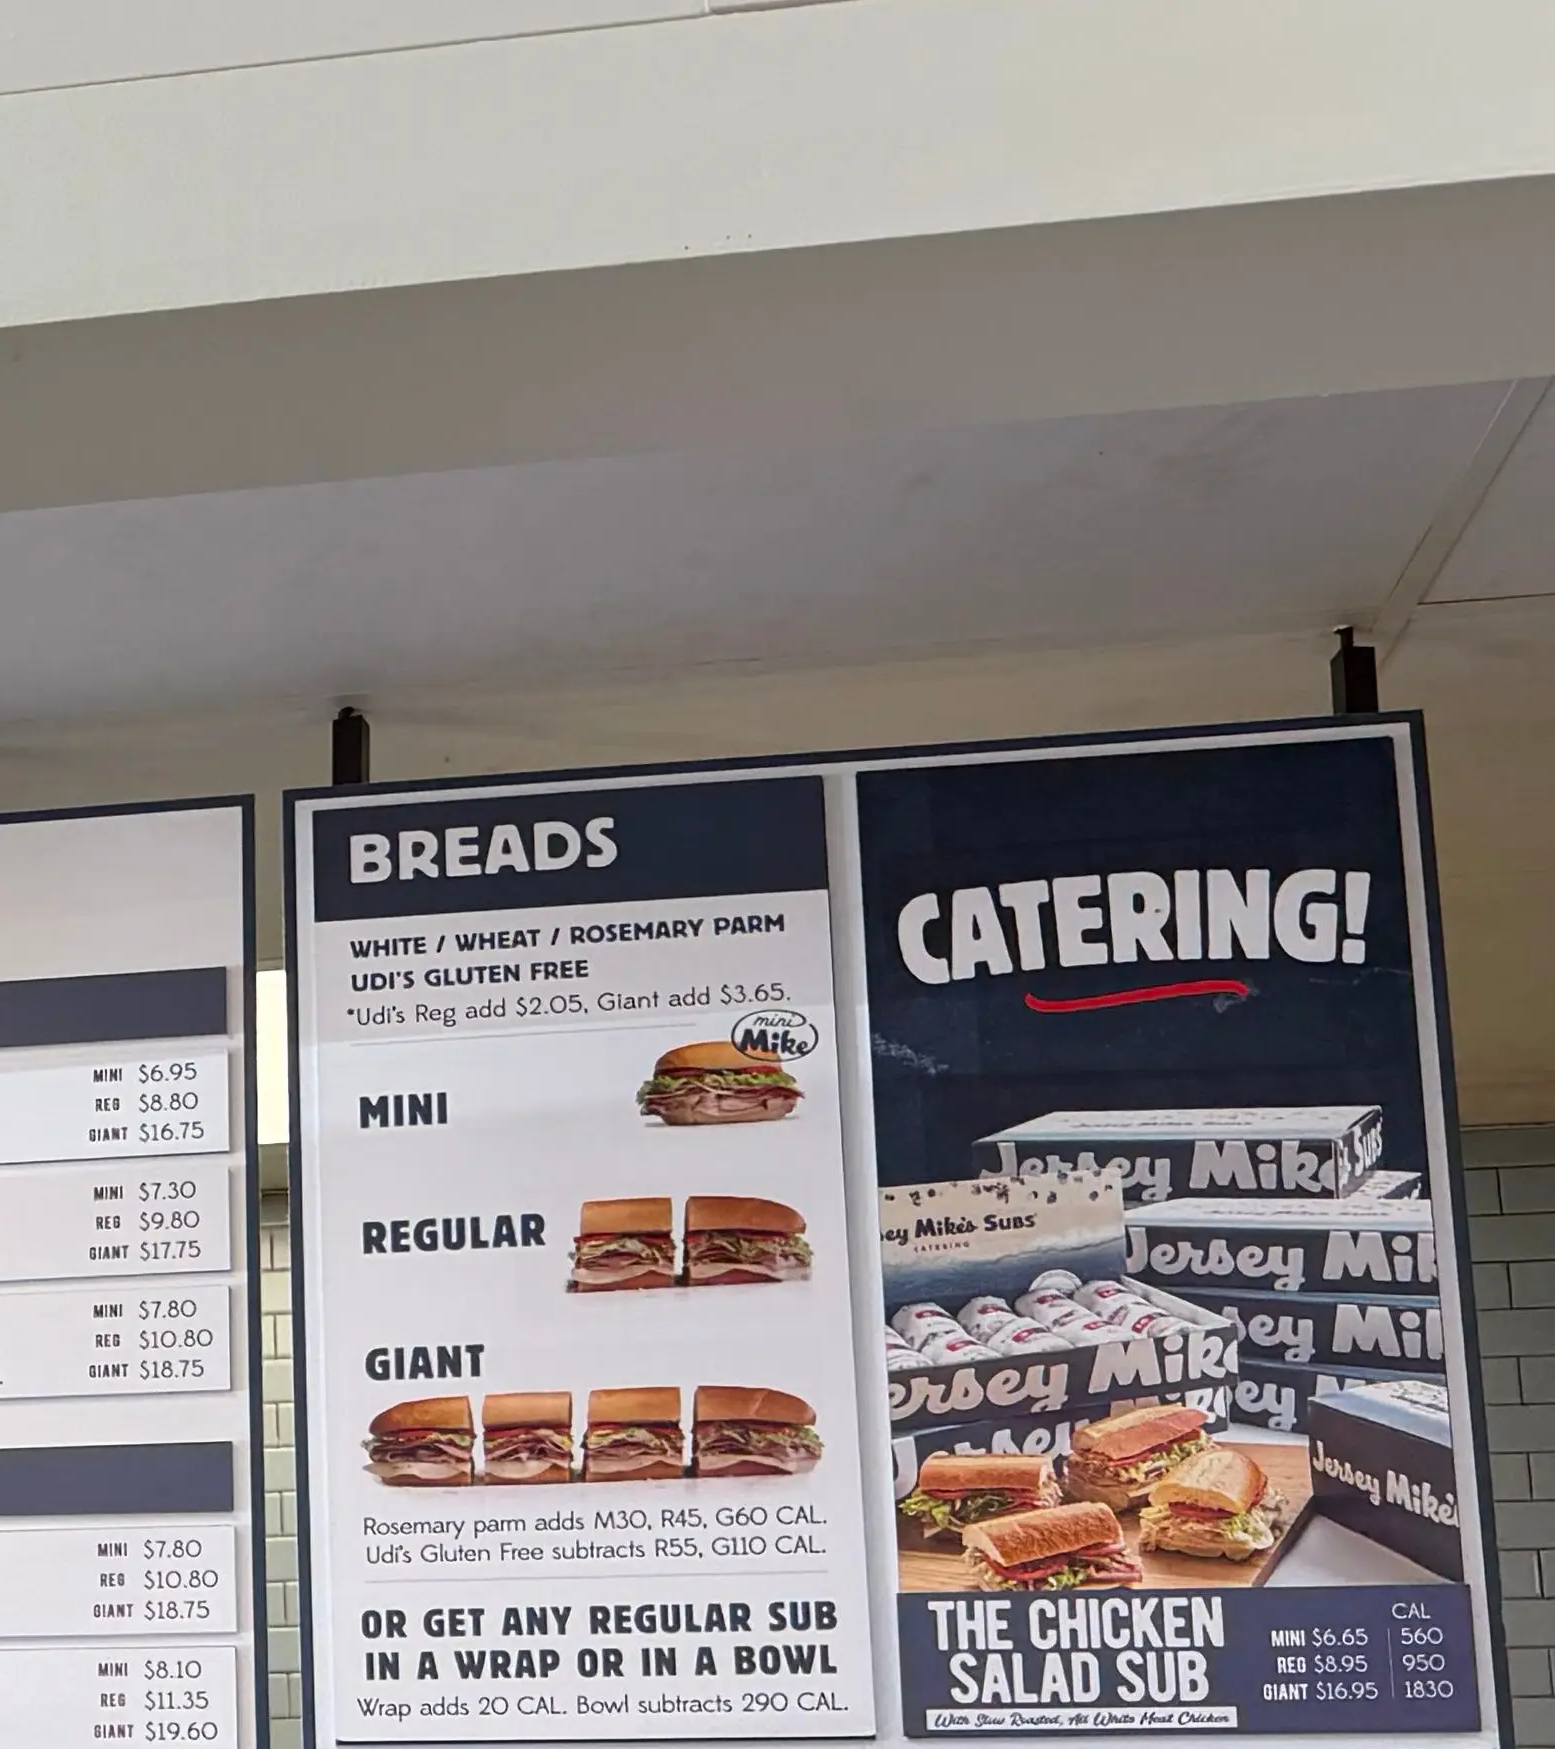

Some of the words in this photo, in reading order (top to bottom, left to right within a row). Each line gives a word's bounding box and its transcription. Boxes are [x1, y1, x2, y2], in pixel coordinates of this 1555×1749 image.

[350, 817, 617, 883] BREADS
[350, 937, 426, 958] WHITE
[437, 936, 445, 953] /
[455, 929, 540, 951] WHEAT
[551, 928, 560, 945] /
[571, 919, 703, 944] ROSEMARY
[714, 914, 784, 935] PARM
[898, 869, 1370, 984] CATERING!
[352, 971, 414, 991] UDI'S
[424, 964, 520, 986] GLUTEN
[531, 960, 588, 980] FREE
[416, 1004, 456, 1027] Reg
[466, 998, 505, 1019] add
[516, 995, 588, 1017] $2.05,
[598, 992, 659, 1011] Giant
[669, 986, 710, 1007] add
[721, 983, 790, 1005] $3.65.
[749, 1009, 807, 1027] mini
[739, 1028, 809, 1056] Mike
[360, 1092, 447, 1128] MINI
[363, 1214, 545, 1254] REGULAR
[915, 1217, 978, 1238] Mike's
[1126, 1227, 1306, 1290] Jersey
[366, 1344, 484, 1380] GIANT
[1311, 1439, 1381, 1503] Jersey
